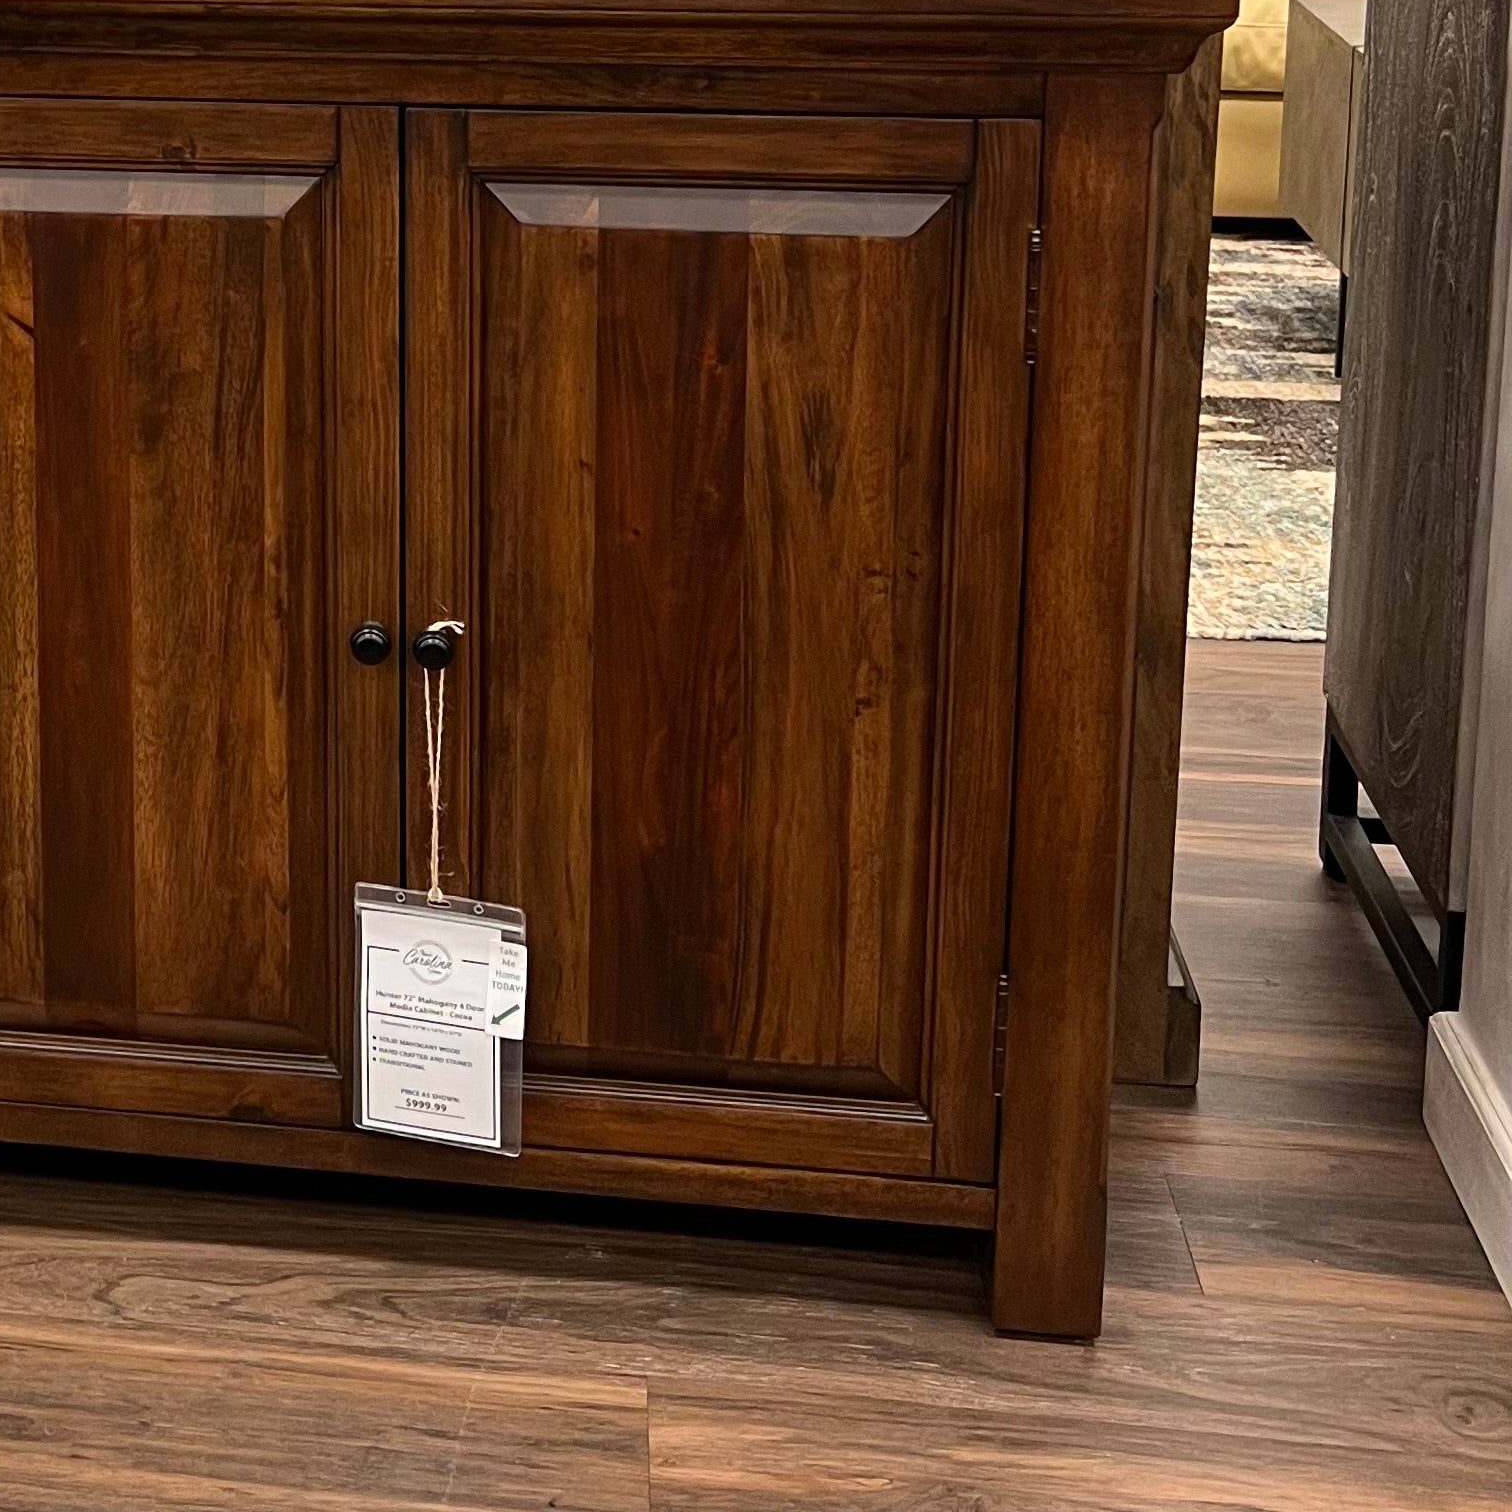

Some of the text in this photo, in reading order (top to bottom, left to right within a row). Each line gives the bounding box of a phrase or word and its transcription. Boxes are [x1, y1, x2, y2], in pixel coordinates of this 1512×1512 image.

[403, 948, 452, 969] Carolina
[499, 946, 519, 958] Take
[502, 958, 516, 968] Me
[495, 969, 521, 981] Home
[491, 980, 524, 994] TODAY!
[418, 996, 458, 1010] Mahogany
[466, 1003, 485, 1012] Door
[389, 1002, 473, 1021] Media Cabinet Cocoa
[405, 1098, 447, 1112] $999.99
